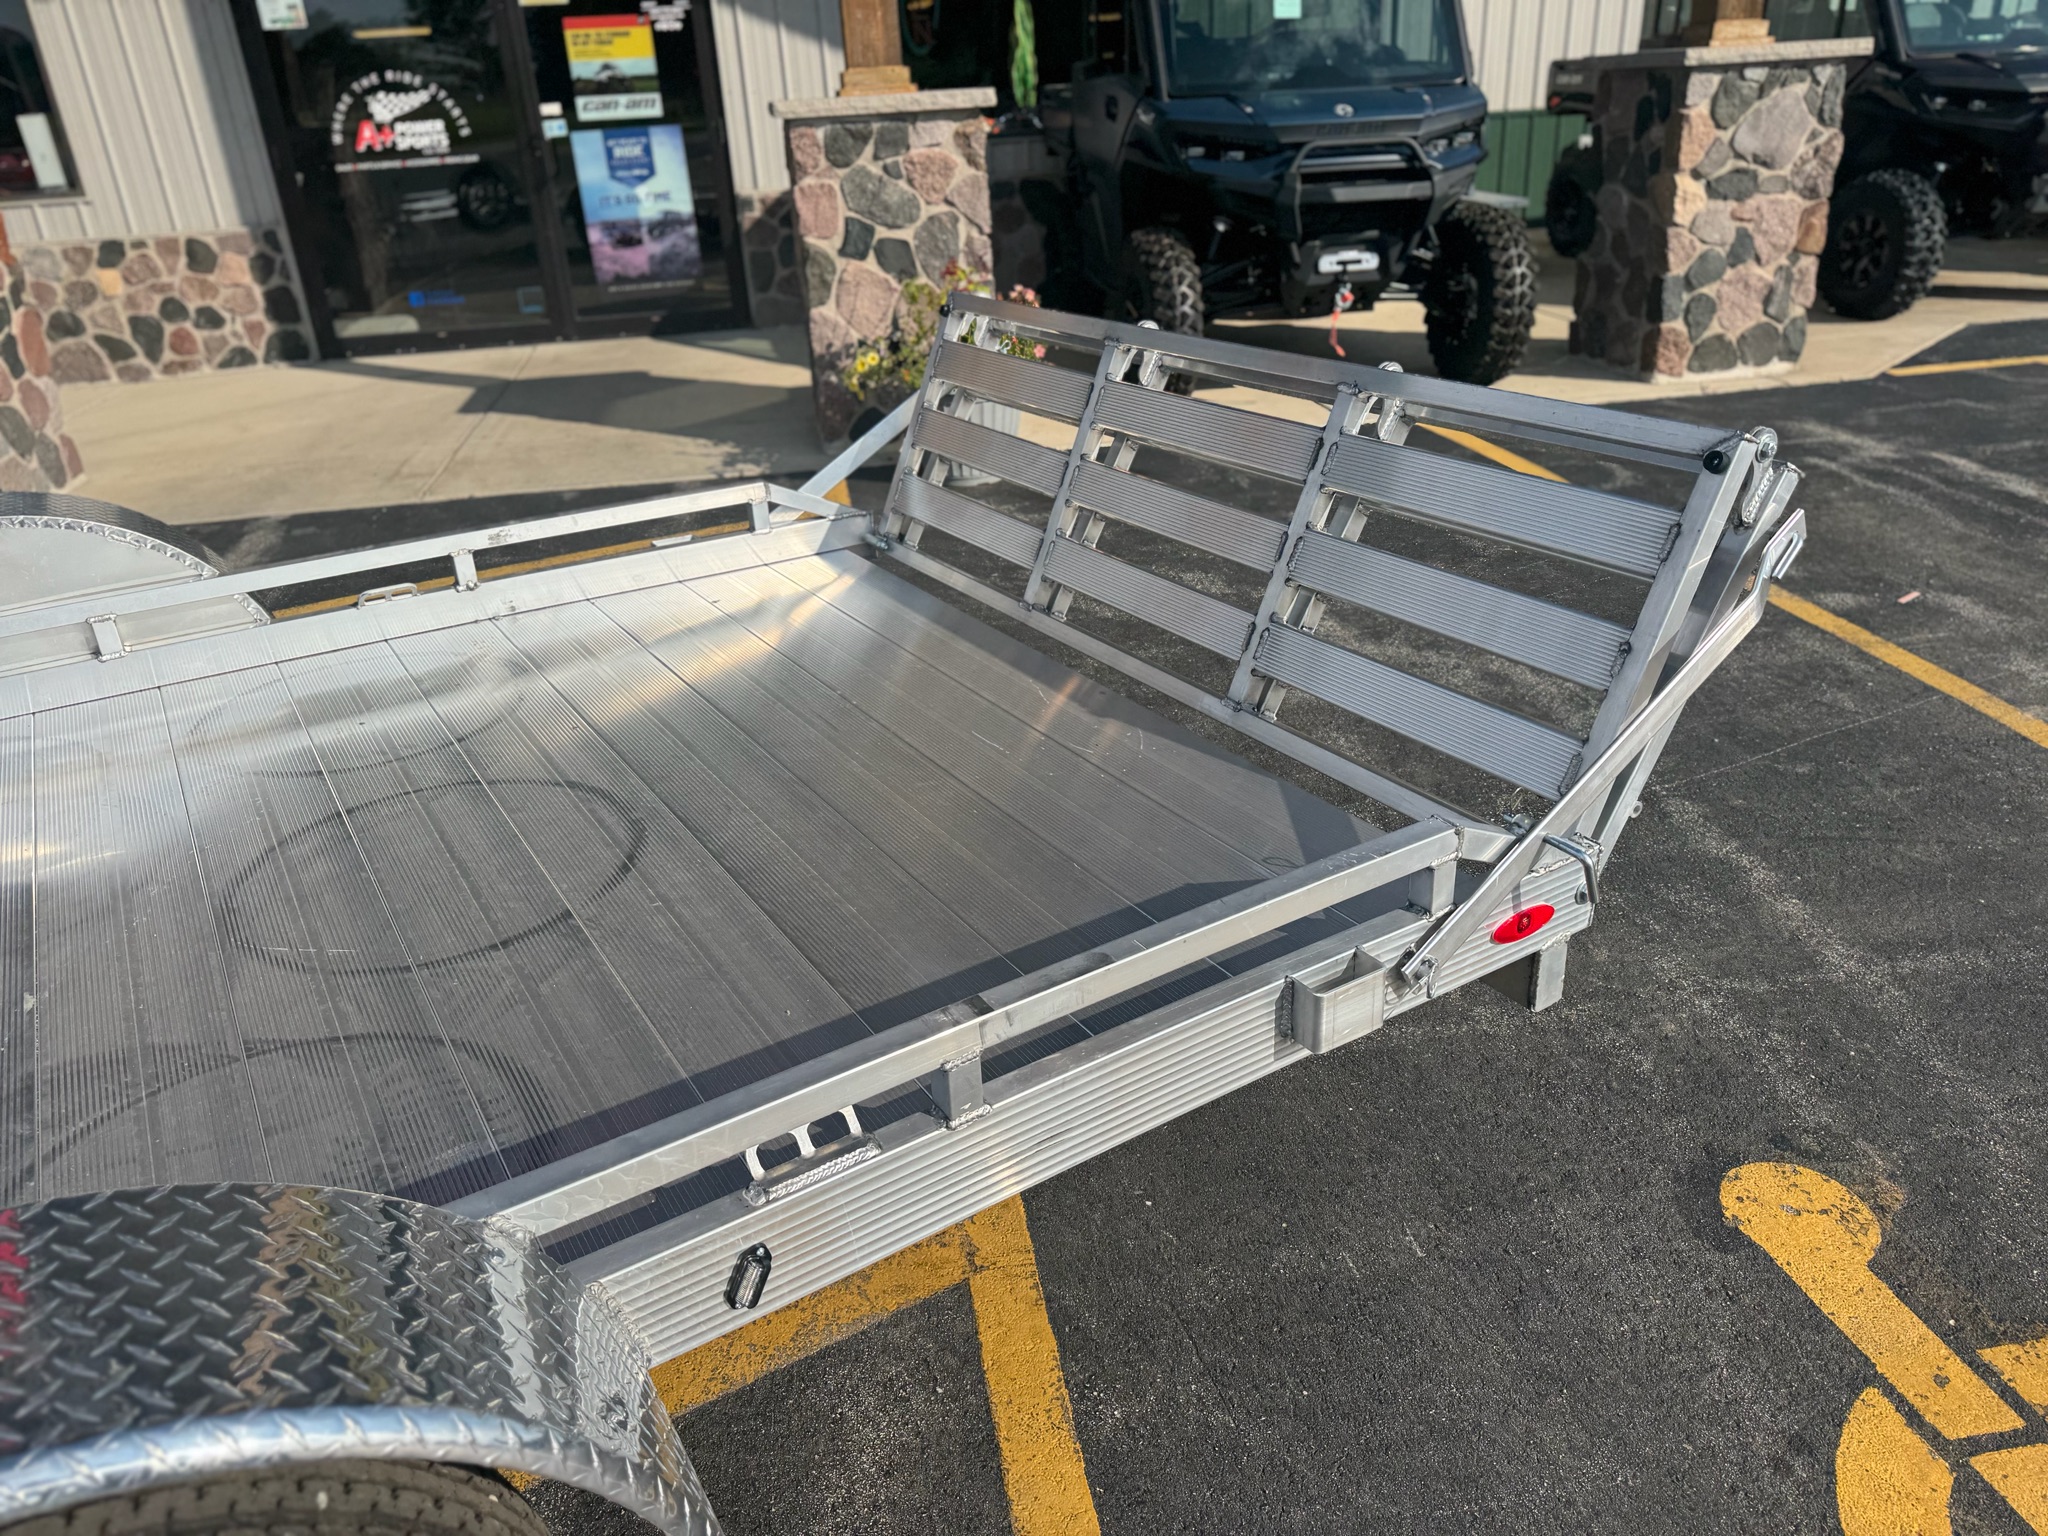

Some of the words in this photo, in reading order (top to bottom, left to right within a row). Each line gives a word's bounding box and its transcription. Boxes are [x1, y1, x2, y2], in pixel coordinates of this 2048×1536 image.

[331, 92, 354, 146] WHERE
[350, 71, 381, 94] THE
[384, 69, 423, 88] RIDE
[428, 82, 472, 138] STARTS
[393, 118, 446, 136] POWER
[394, 132, 451, 151] SPORTS
